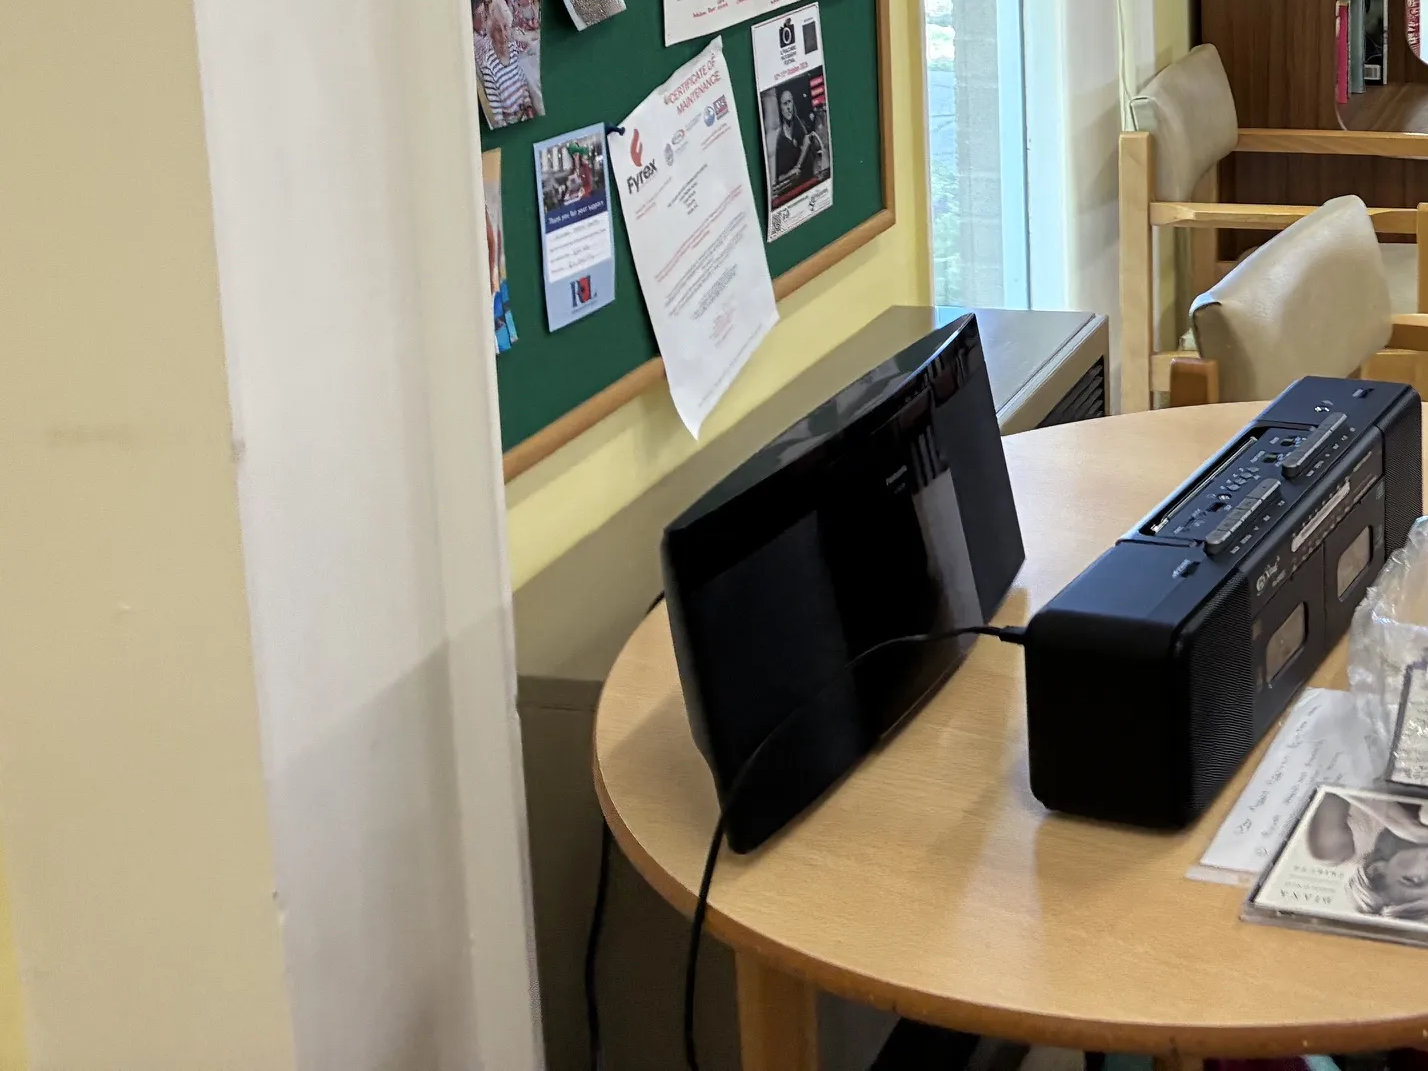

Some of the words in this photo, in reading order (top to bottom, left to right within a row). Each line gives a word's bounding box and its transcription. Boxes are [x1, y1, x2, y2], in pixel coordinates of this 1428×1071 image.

[667, 64, 709, 105] CERTIFICATE
[706, 52, 716, 71] OF
[676, 70, 722, 116] MAINTENANCE
[626, 158, 658, 195] Fyrex
[548, 215, 562, 226] Thank
[561, 213, 570, 222] you
[569, 209, 578, 218] for
[577, 205, 588, 217] your
[588, 199, 605, 210] support
